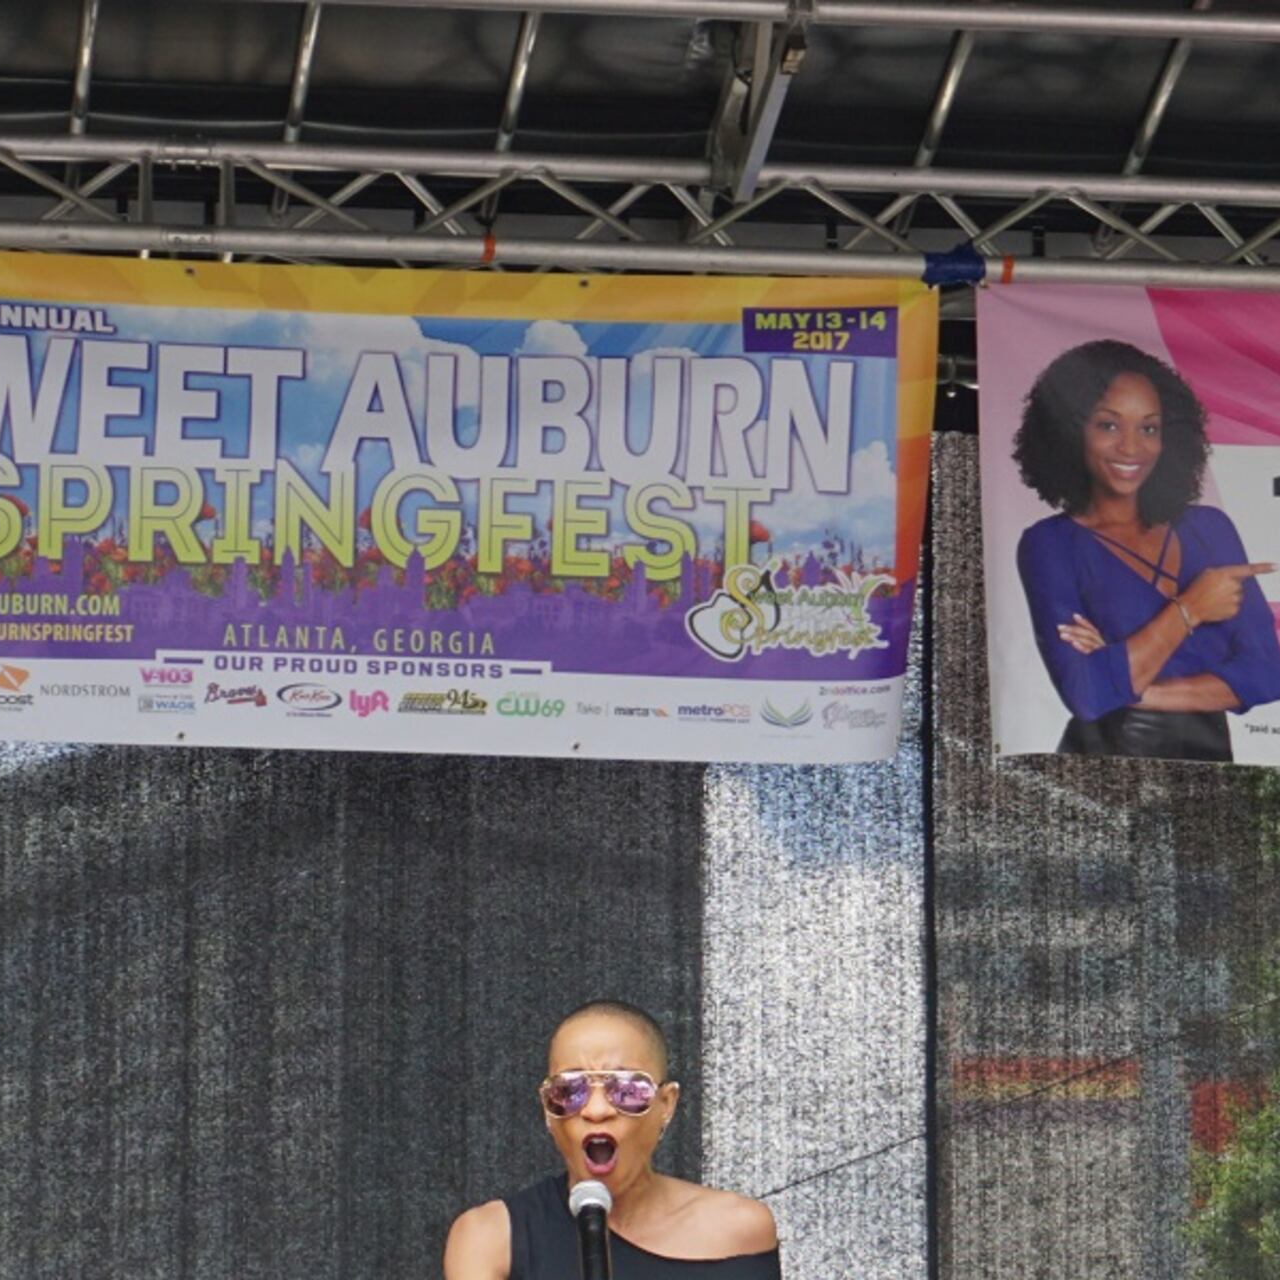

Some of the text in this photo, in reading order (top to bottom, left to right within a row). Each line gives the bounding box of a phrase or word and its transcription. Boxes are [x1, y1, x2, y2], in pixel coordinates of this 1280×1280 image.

[755, 312, 811, 330] MAY
[793, 331, 850, 351] 2017
[320, 352, 856, 494] AUBURN
[222, 624, 495, 655] ATLANTA, GEORGIA
[138, 667, 194, 684] V-103
[214, 655, 503, 679] OUR PROUD SPONSORS
[39, 683, 131, 698] NORDSTROM
[614, 705, 649, 718] marta
[678, 704, 750, 717] metroPCS
